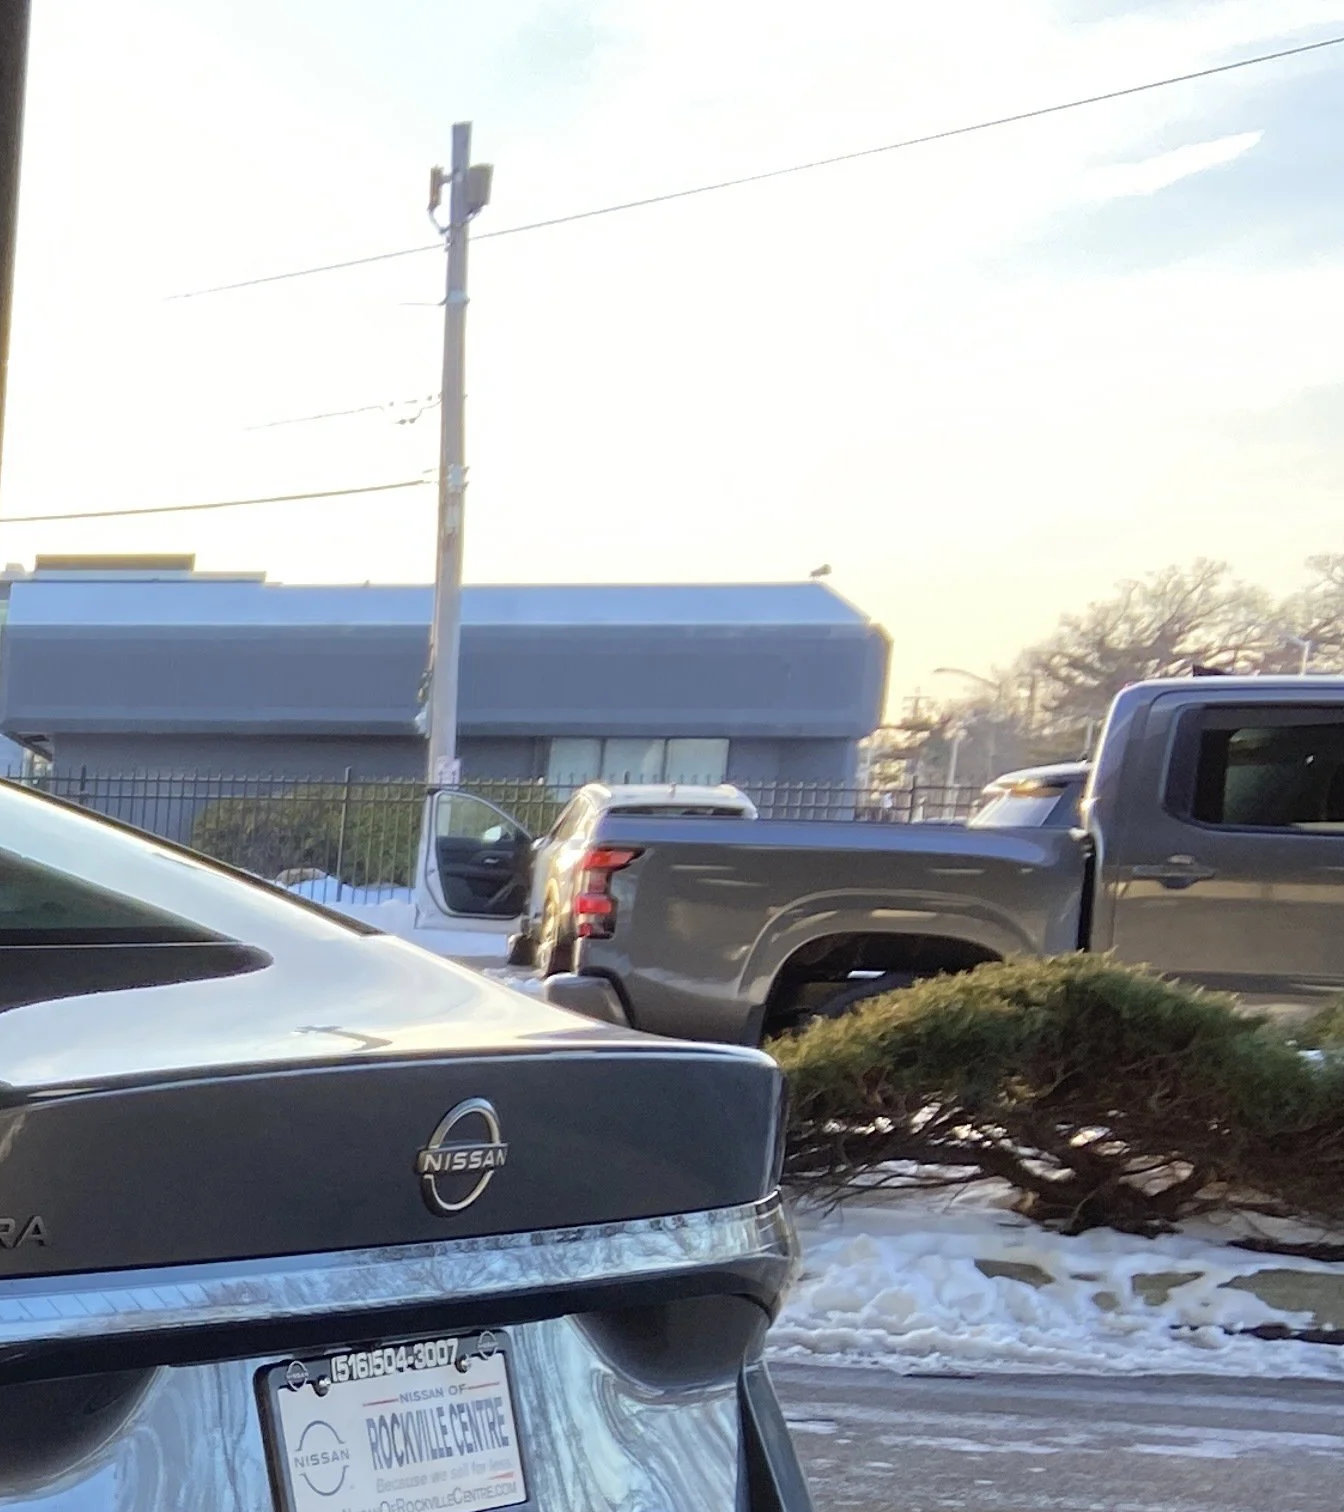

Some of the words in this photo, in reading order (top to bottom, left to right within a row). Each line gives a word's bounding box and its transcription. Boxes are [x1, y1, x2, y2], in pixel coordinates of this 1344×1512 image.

[423, 1148, 507, 1172] NISSAN
[330, 1338, 459, 1383] (516)504-3007
[399, 1387, 444, 1404] NISSAN
[448, 1384, 467, 1396] OF
[366, 1406, 453, 1471] ROCKVILLE
[448, 1396, 510, 1456] CENTRE
[294, 1449, 350, 1468] NISSAN
[376, 1474, 428, 1493] Because
